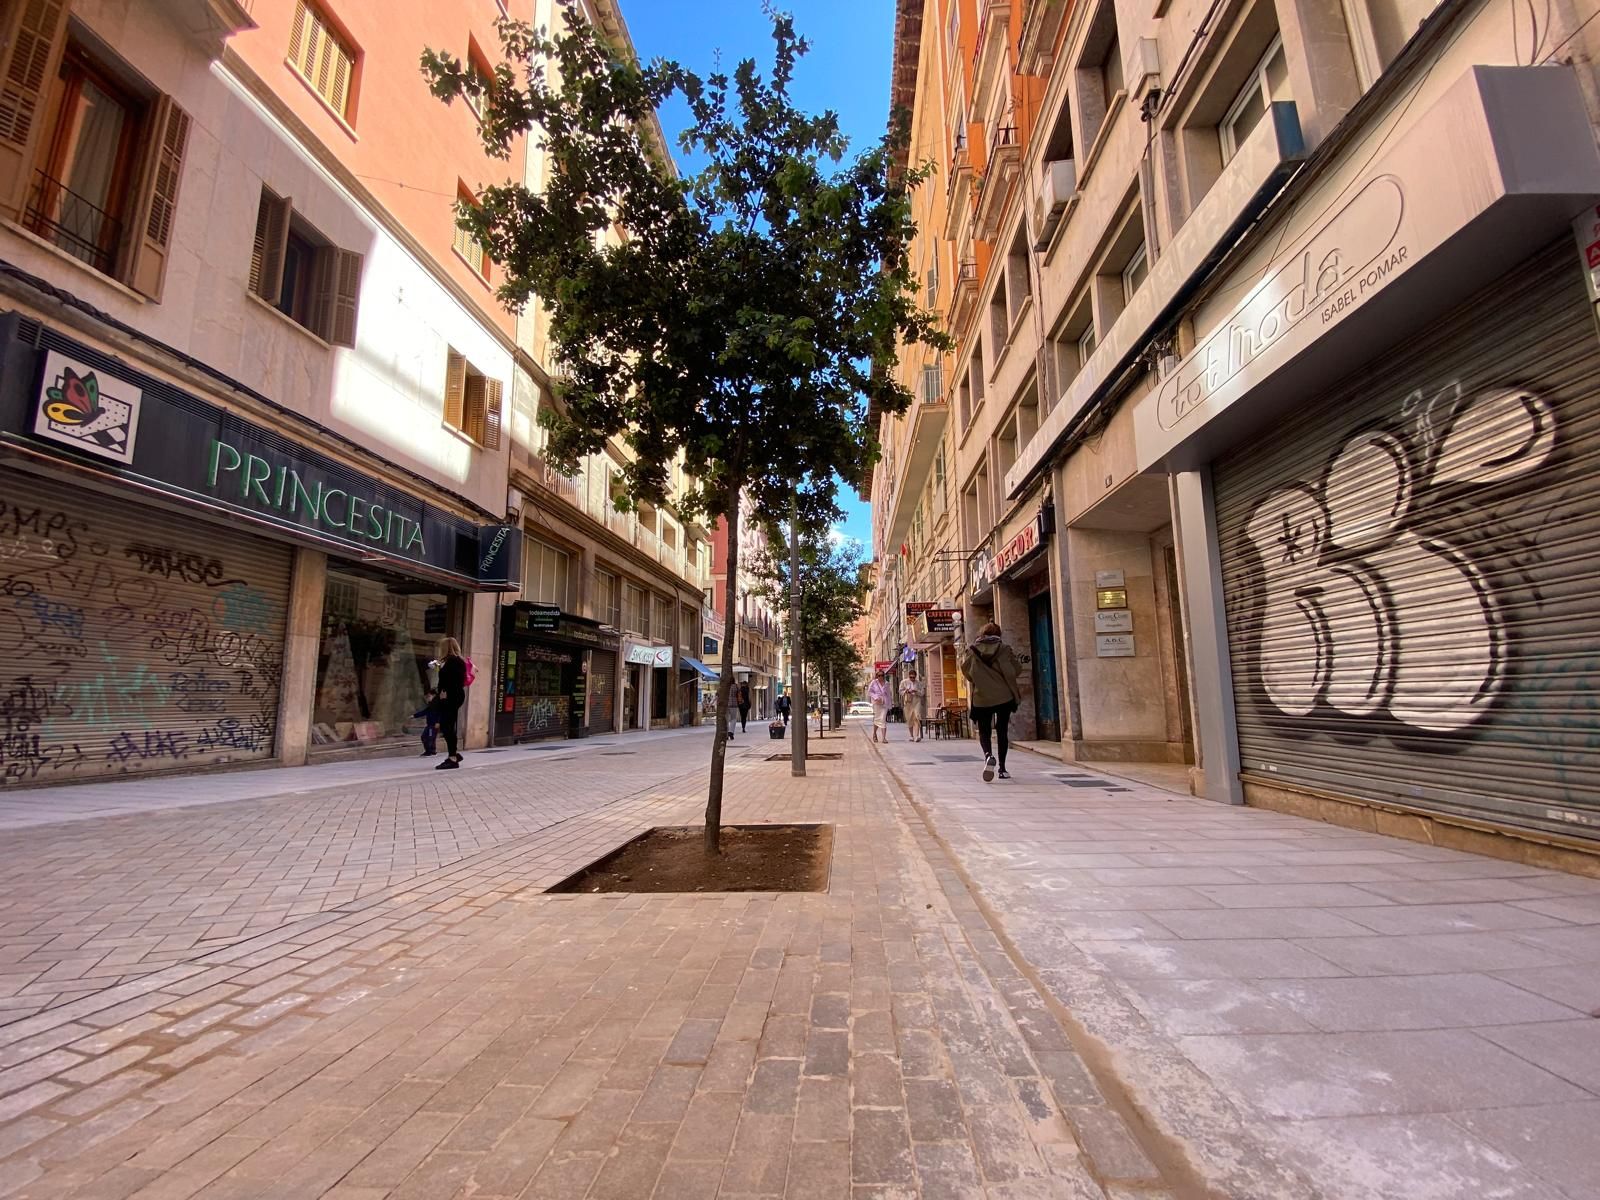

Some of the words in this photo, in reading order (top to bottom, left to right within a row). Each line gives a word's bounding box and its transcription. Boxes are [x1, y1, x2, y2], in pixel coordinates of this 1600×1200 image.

[1321, 289, 1357, 325] ISABEL
[1359, 246, 1409, 295] POMAR
[1171, 347, 1218, 417] tot
[207, 438, 426, 555] PRINCESITA
[480, 527, 511, 572] PRINCESITA
[997, 526, 1035, 573] DECOR
